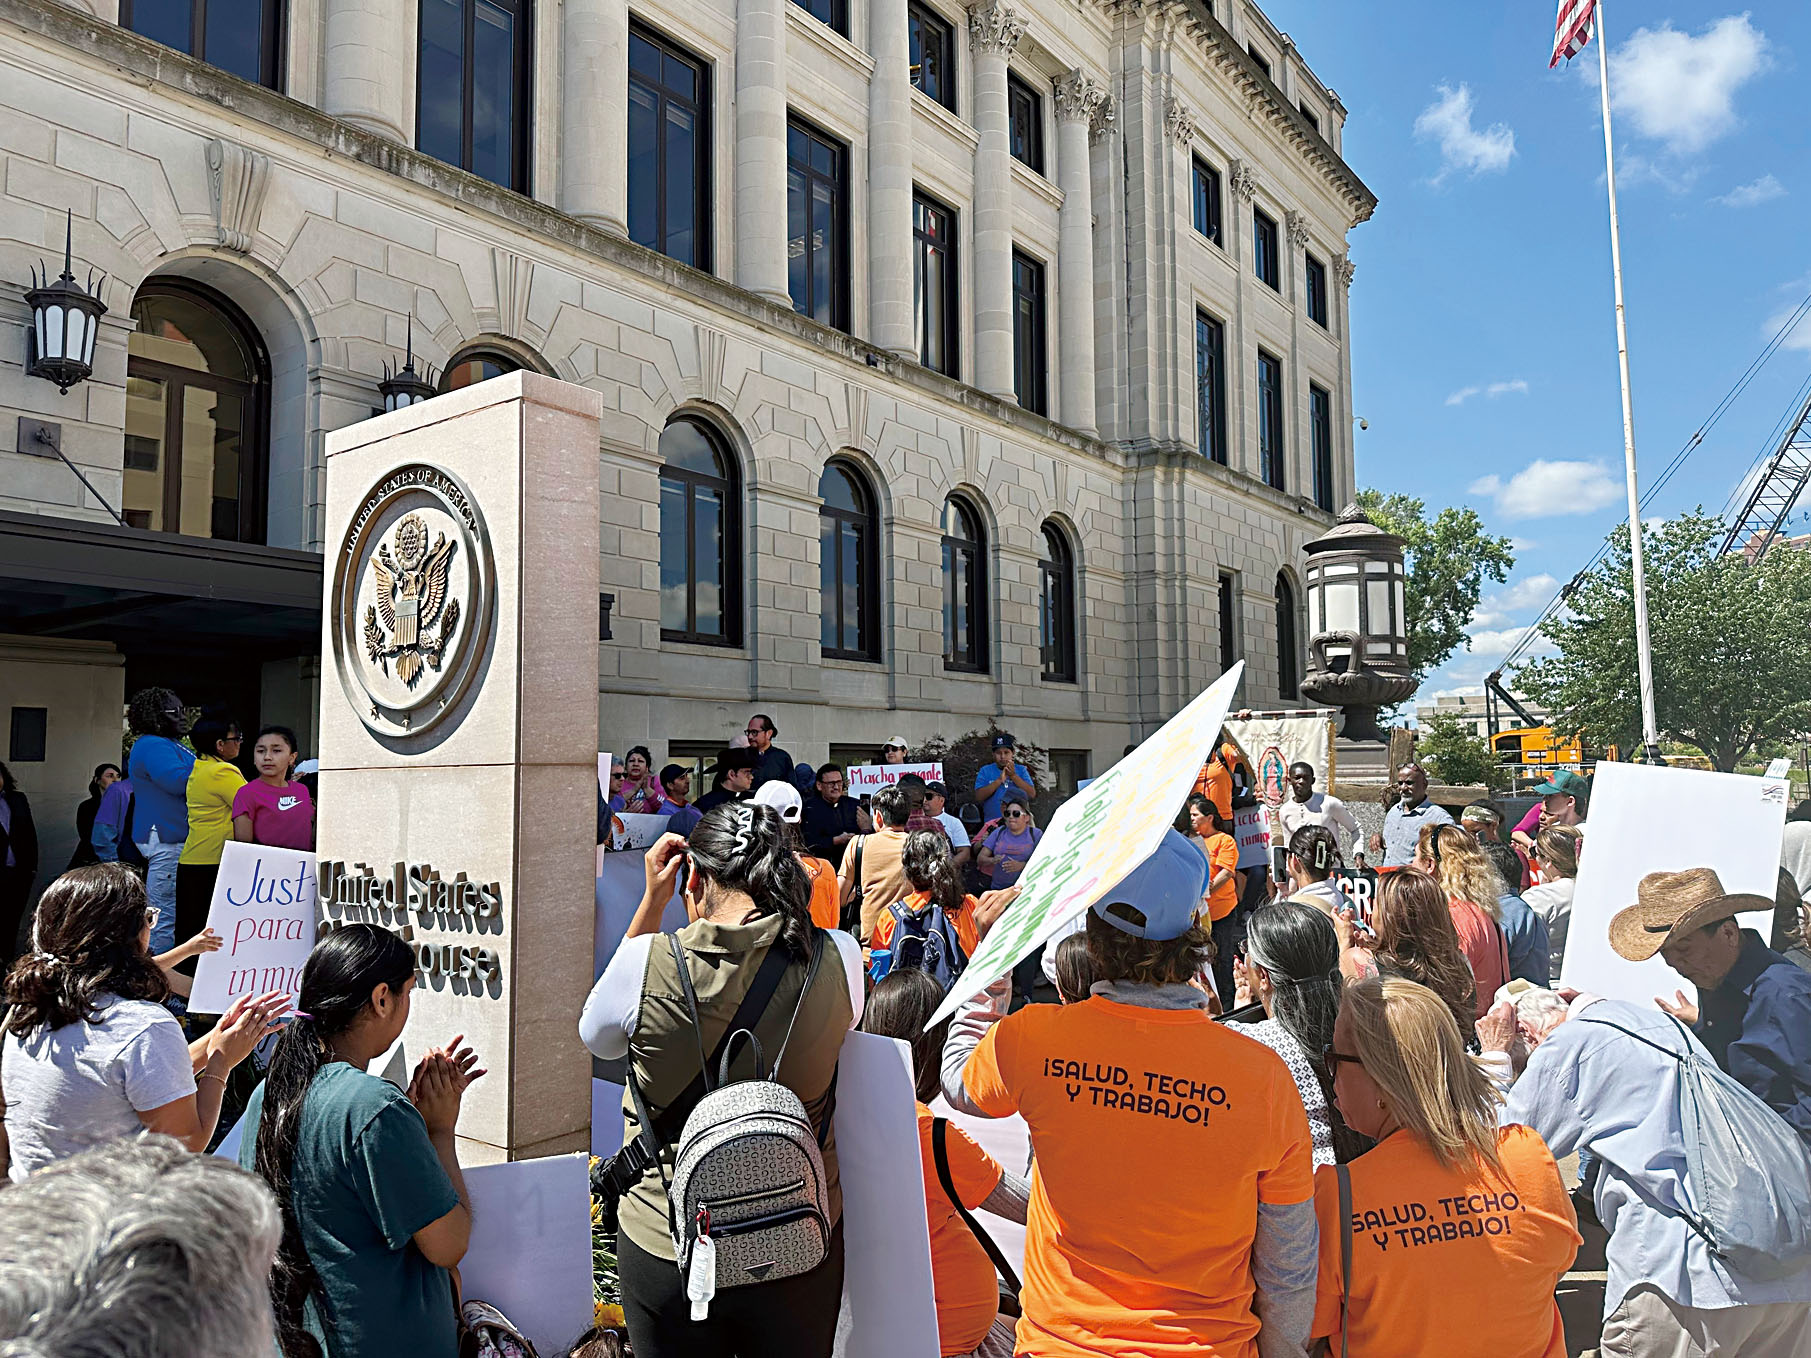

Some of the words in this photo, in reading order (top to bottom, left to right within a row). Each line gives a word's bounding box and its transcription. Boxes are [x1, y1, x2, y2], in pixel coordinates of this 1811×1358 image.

[347, 498, 379, 554] UNITED
[377, 471, 415, 500] STATES
[416, 469, 432, 482] OF
[433, 474, 478, 532] AMERICA
[227, 858, 316, 907] Just
[317, 861, 405, 909] United
[408, 863, 500, 918] States
[231, 917, 304, 957] para
[1043, 1057, 1134, 1091] ¡SALUD,
[1143, 1071, 1232, 1111] TECHO,
[1065, 1083, 1082, 1102] Y
[1088, 1086, 1210, 1128] TRABAJO!
[1438, 1191, 1527, 1218] TECHO,
[1372, 1232, 1388, 1252] Y
[1394, 1215, 1512, 1248] TRABAJO!
